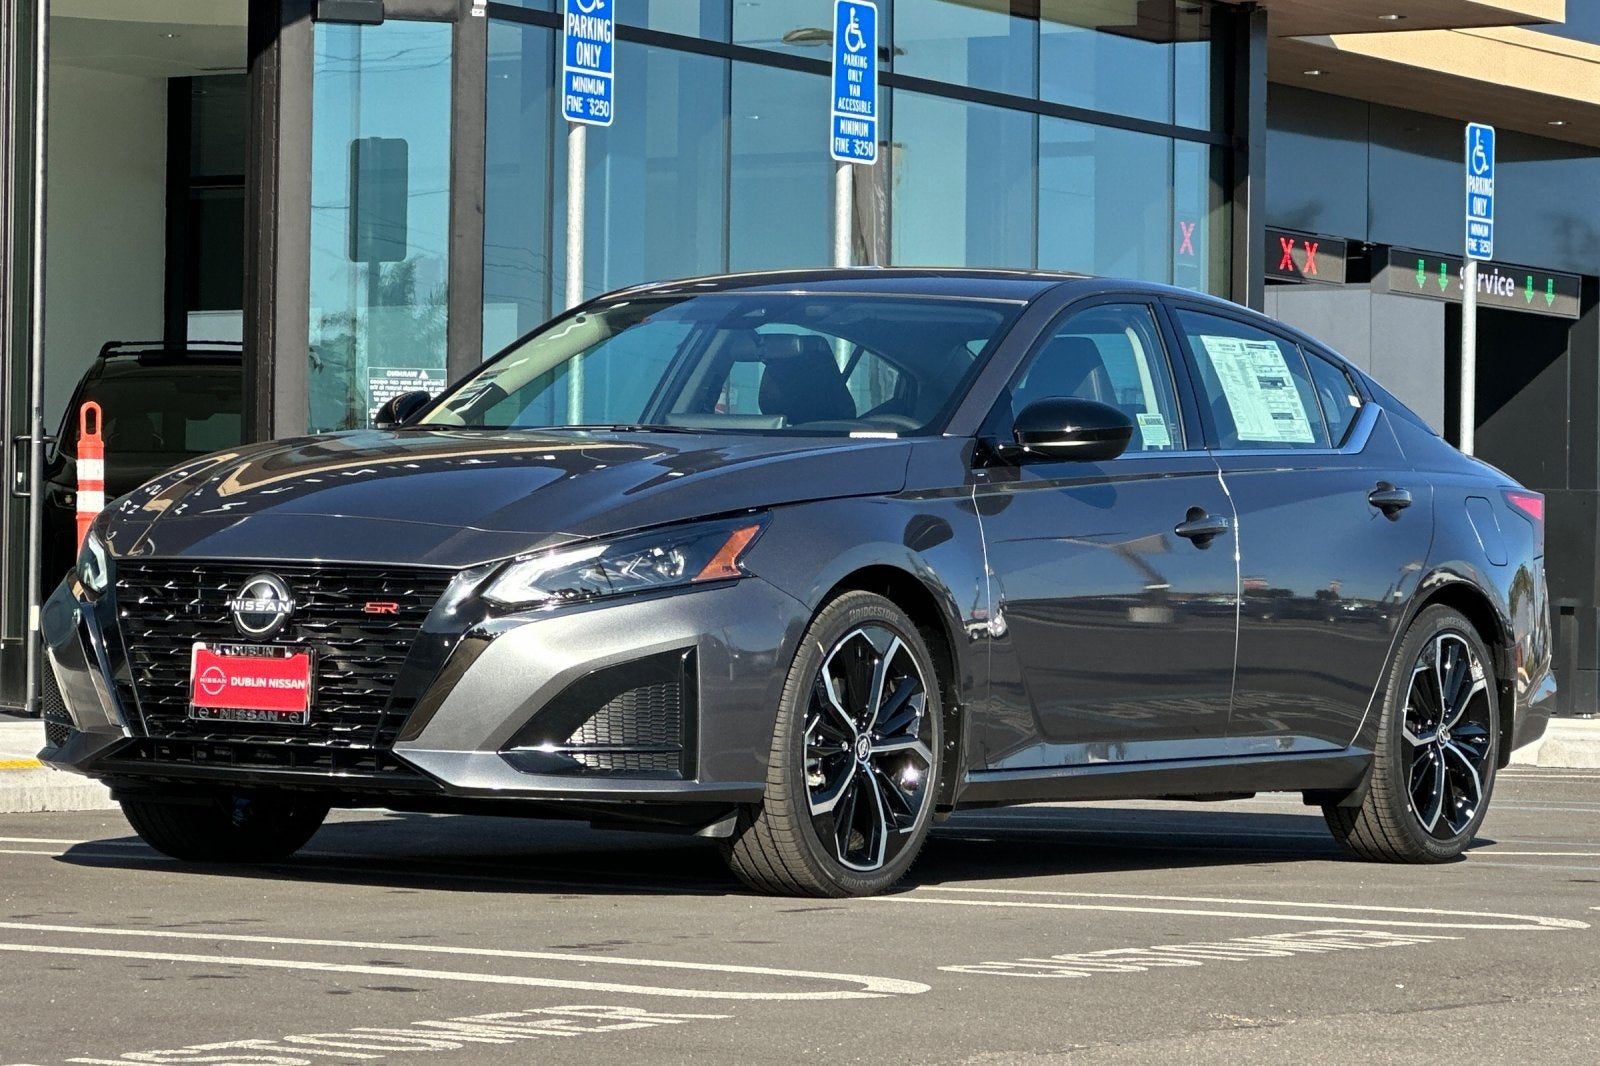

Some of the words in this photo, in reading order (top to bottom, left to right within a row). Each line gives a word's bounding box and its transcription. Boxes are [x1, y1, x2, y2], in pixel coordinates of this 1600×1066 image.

[568, 13, 611, 43] PARKING
[576, 41, 602, 68] ONLY
[843, 53, 868, 69] PARKING
[572, 75, 605, 96] MINIMUM
[847, 68, 863, 83] ONLY
[849, 83, 861, 97] VAN
[566, 95, 584, 113] FINE
[587, 97, 609, 117] $250
[838, 96, 872, 114] ACCESSIBLE
[840, 118, 869, 138] MINIMUM
[835, 137, 850, 153] FINE
[853, 138, 874, 157] $250
[1468, 174, 1493, 197] PARKING
[1472, 196, 1488, 216] ONLY
[231, 600, 290, 612] NISSAN
[364, 602, 399, 614] SR
[230, 676, 267, 688] DUBLIN
[268, 678, 305, 689] NISSAN
[219, 708, 279, 721] NISSAN
[936, 929, 1465, 978] CUSTOMER
